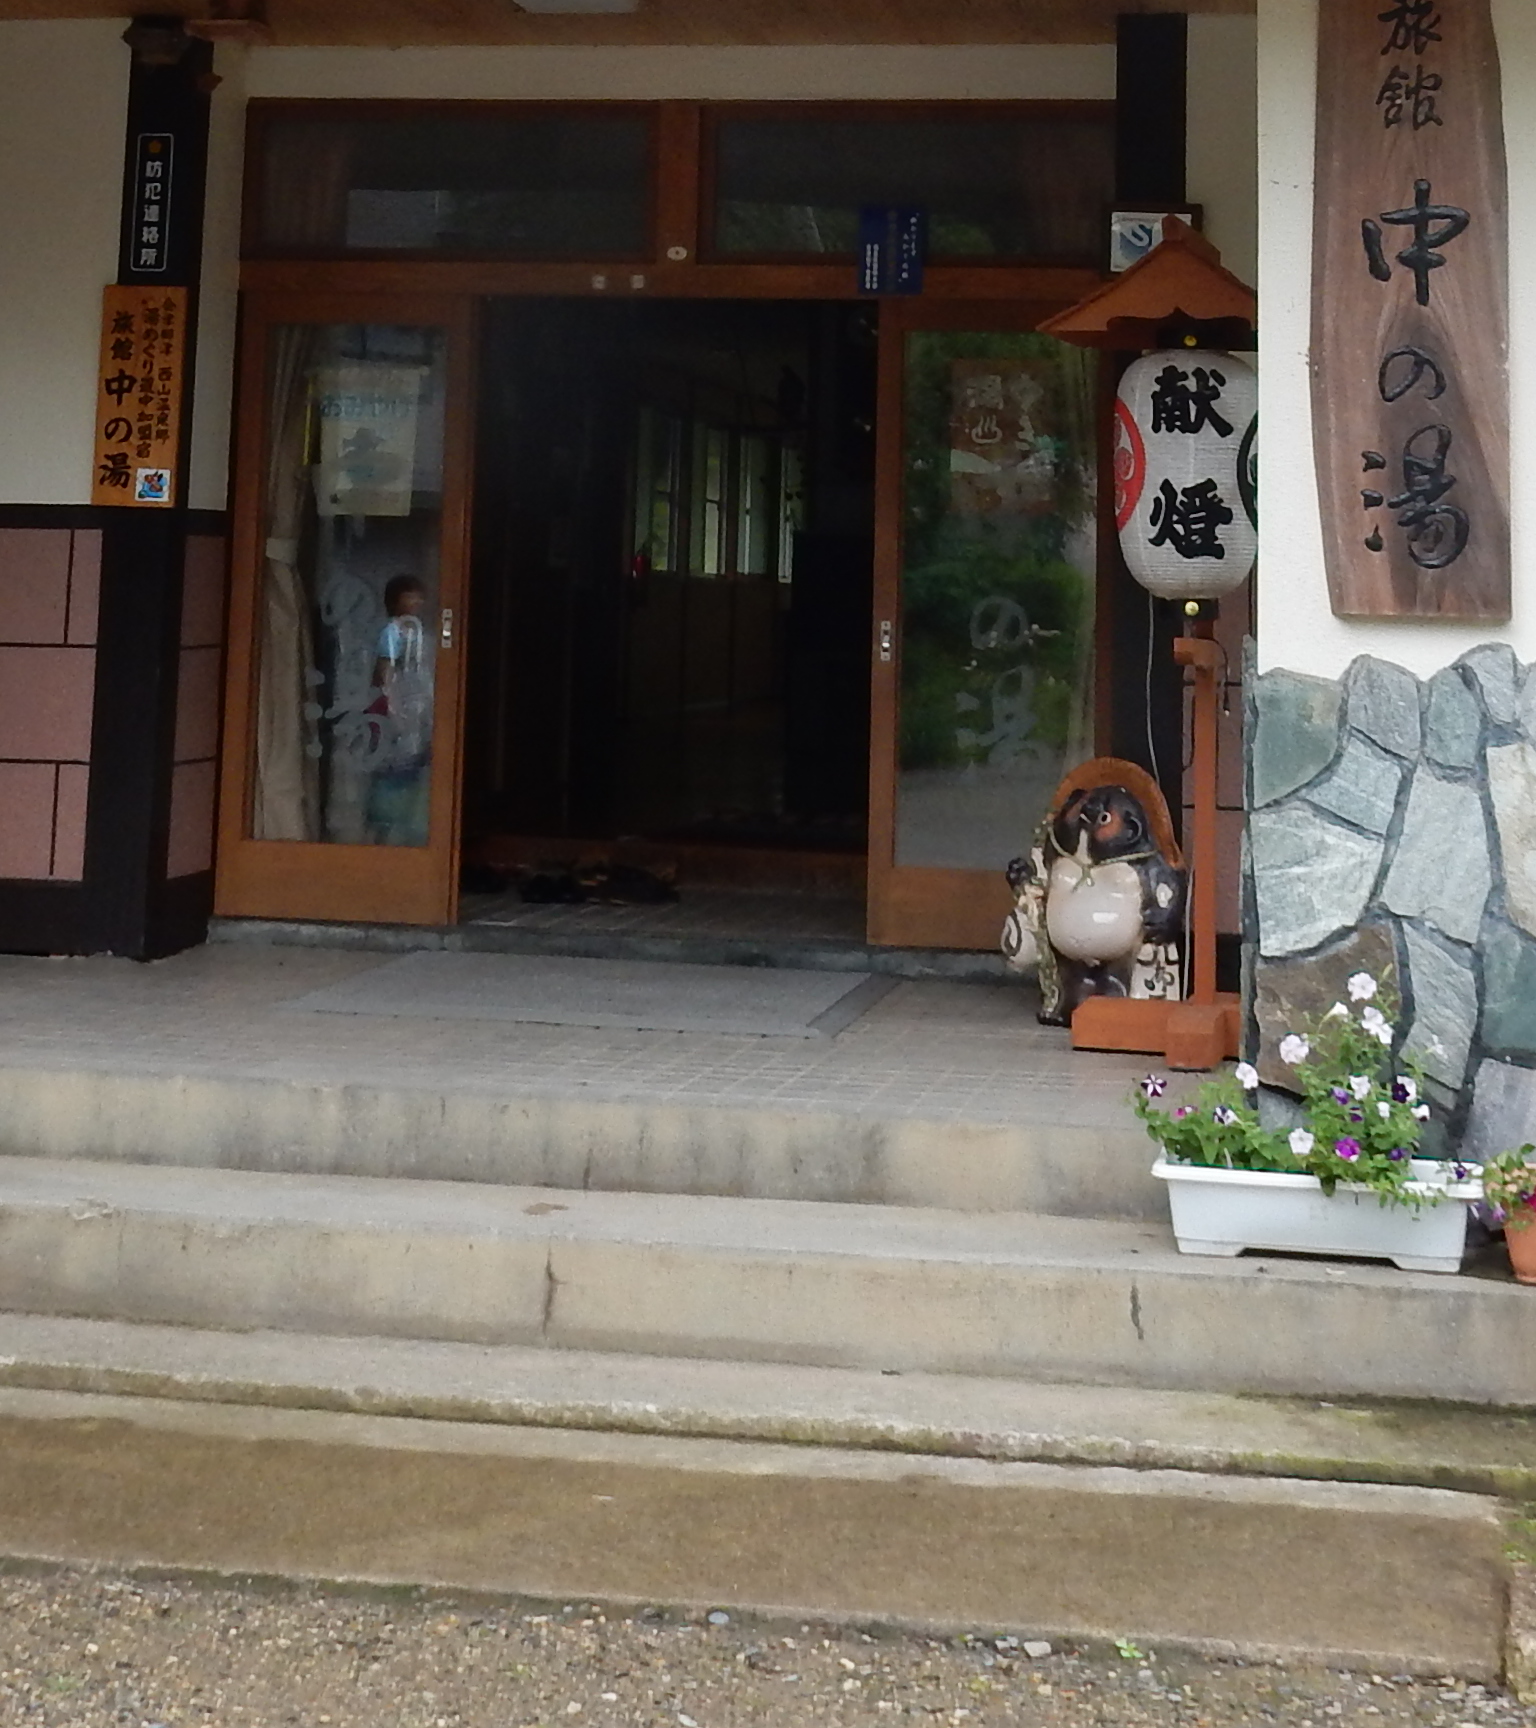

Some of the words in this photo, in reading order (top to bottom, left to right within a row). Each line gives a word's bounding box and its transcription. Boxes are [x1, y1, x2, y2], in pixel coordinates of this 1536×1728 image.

[139, 160, 164, 266] 防犯連絡所
[98, 309, 139, 489] 旅館中の湯
[1148, 364, 1235, 560] 献燈
